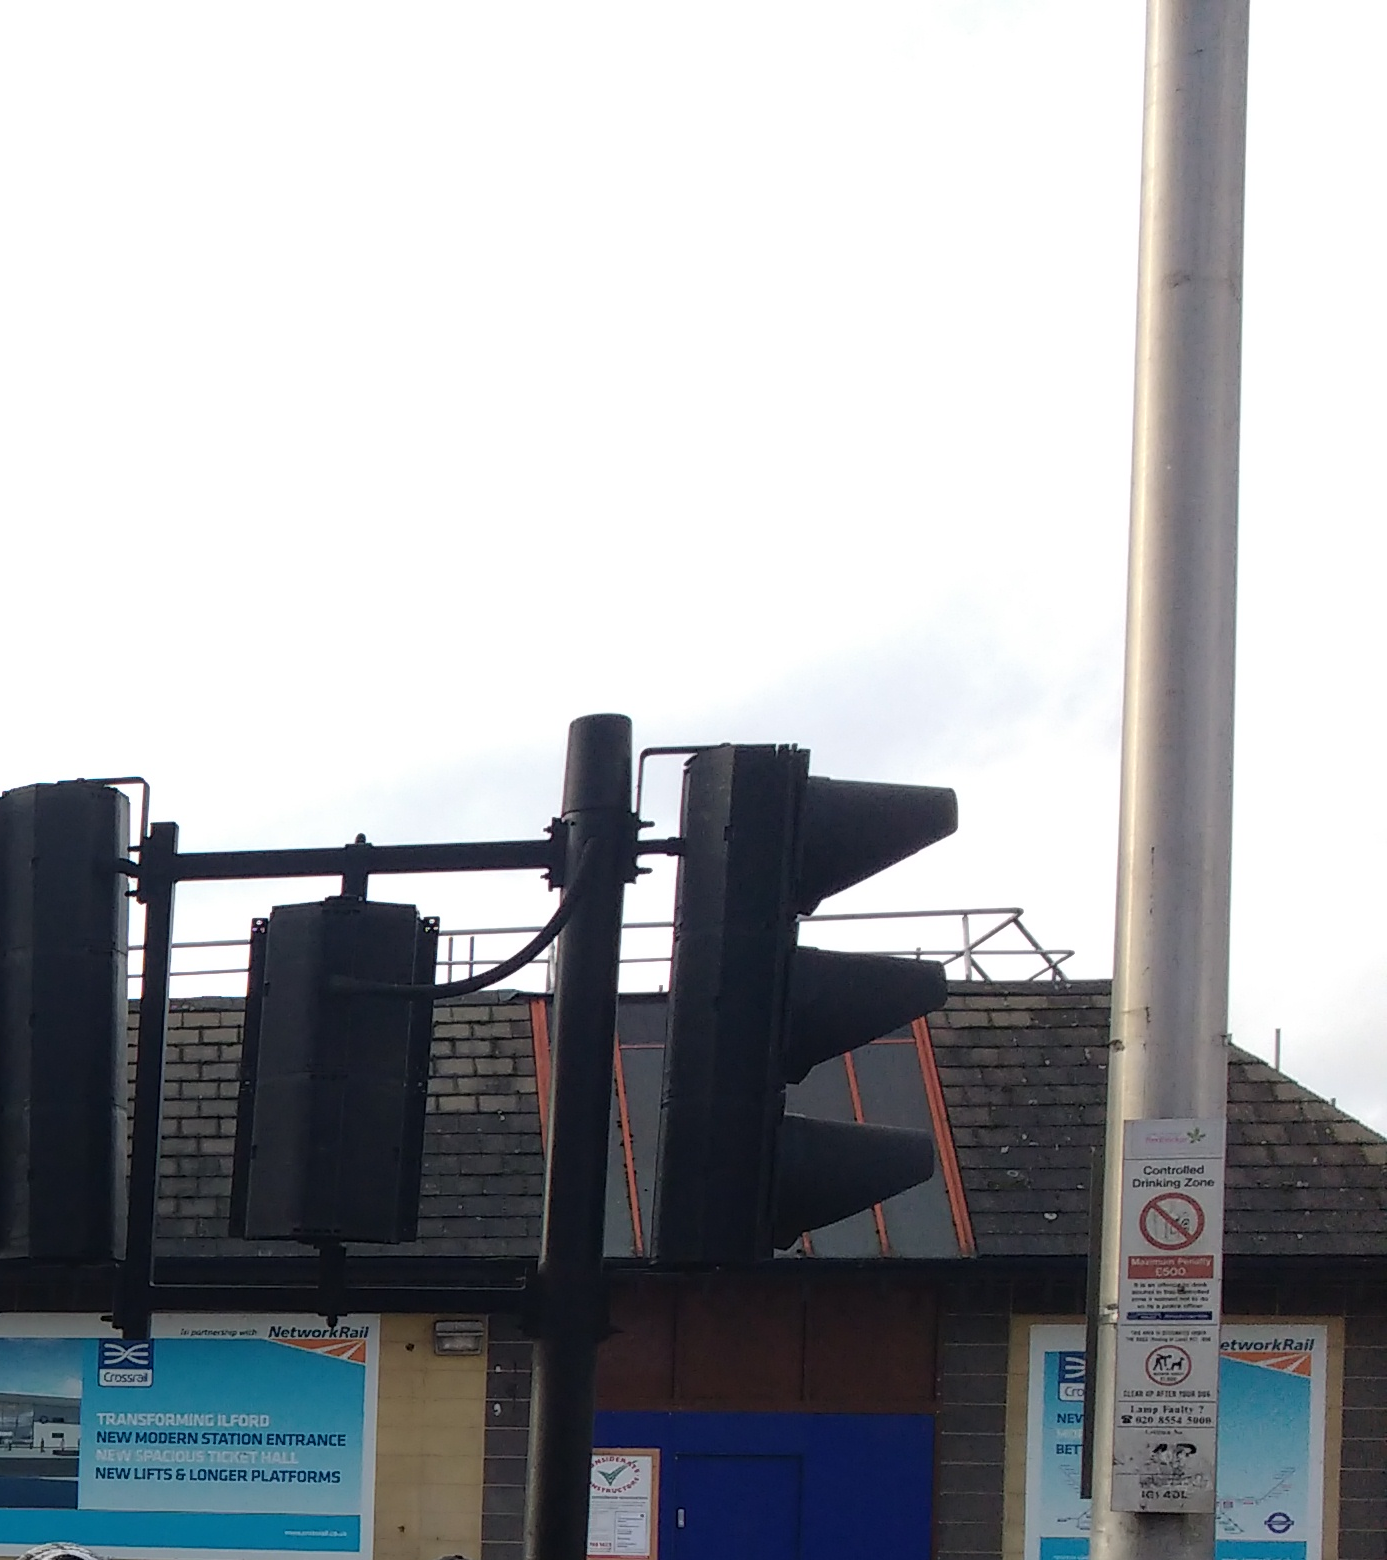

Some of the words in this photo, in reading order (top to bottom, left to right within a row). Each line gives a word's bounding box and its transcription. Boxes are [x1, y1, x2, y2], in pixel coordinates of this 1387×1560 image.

[1143, 1164, 1205, 1176] Controlled
[1132, 1177, 1181, 1189] Drinking
[1183, 1177, 1215, 1188] Zone
[1130, 1257, 1175, 1266] Maximum
[1178, 1258, 1212, 1268] Penalty
[1155, 1266, 1187, 1277] £500
[191, 1328, 237, 1338] partnership
[1220, 1338, 1315, 1352] etworkRail
[103, 1371, 149, 1384] Crossrail
[1130, 1405, 1158, 1415] Lamp
[1162, 1405, 1193, 1415] Faulty
[96, 1412, 215, 1427] TRANSFORMING
[217, 1413, 270, 1427] ILFORD
[1135, 1415, 1154, 1425] 020
[1158, 1415, 1183, 1425] 8554
[1186, 1415, 1212, 1425] 5000
[96, 1431, 133, 1444] NEW
[135, 1432, 199, 1446] MODERN
[201, 1432, 266, 1446] STATION
[266, 1433, 346, 1447] ENTRANCE
[95, 1449, 133, 1462] NEW
[135, 1450, 205, 1464] SPACIOUS
[208, 1451, 259, 1465] TICKET
[261, 1452, 300, 1465] HALL
[95, 1467, 132, 1480] NEW
[134, 1468, 173, 1481] LIFTS
[175, 1468, 187, 1481] &
[189, 1469, 249, 1483] LONGER
[251, 1469, 342, 1484] PLATFORMS
